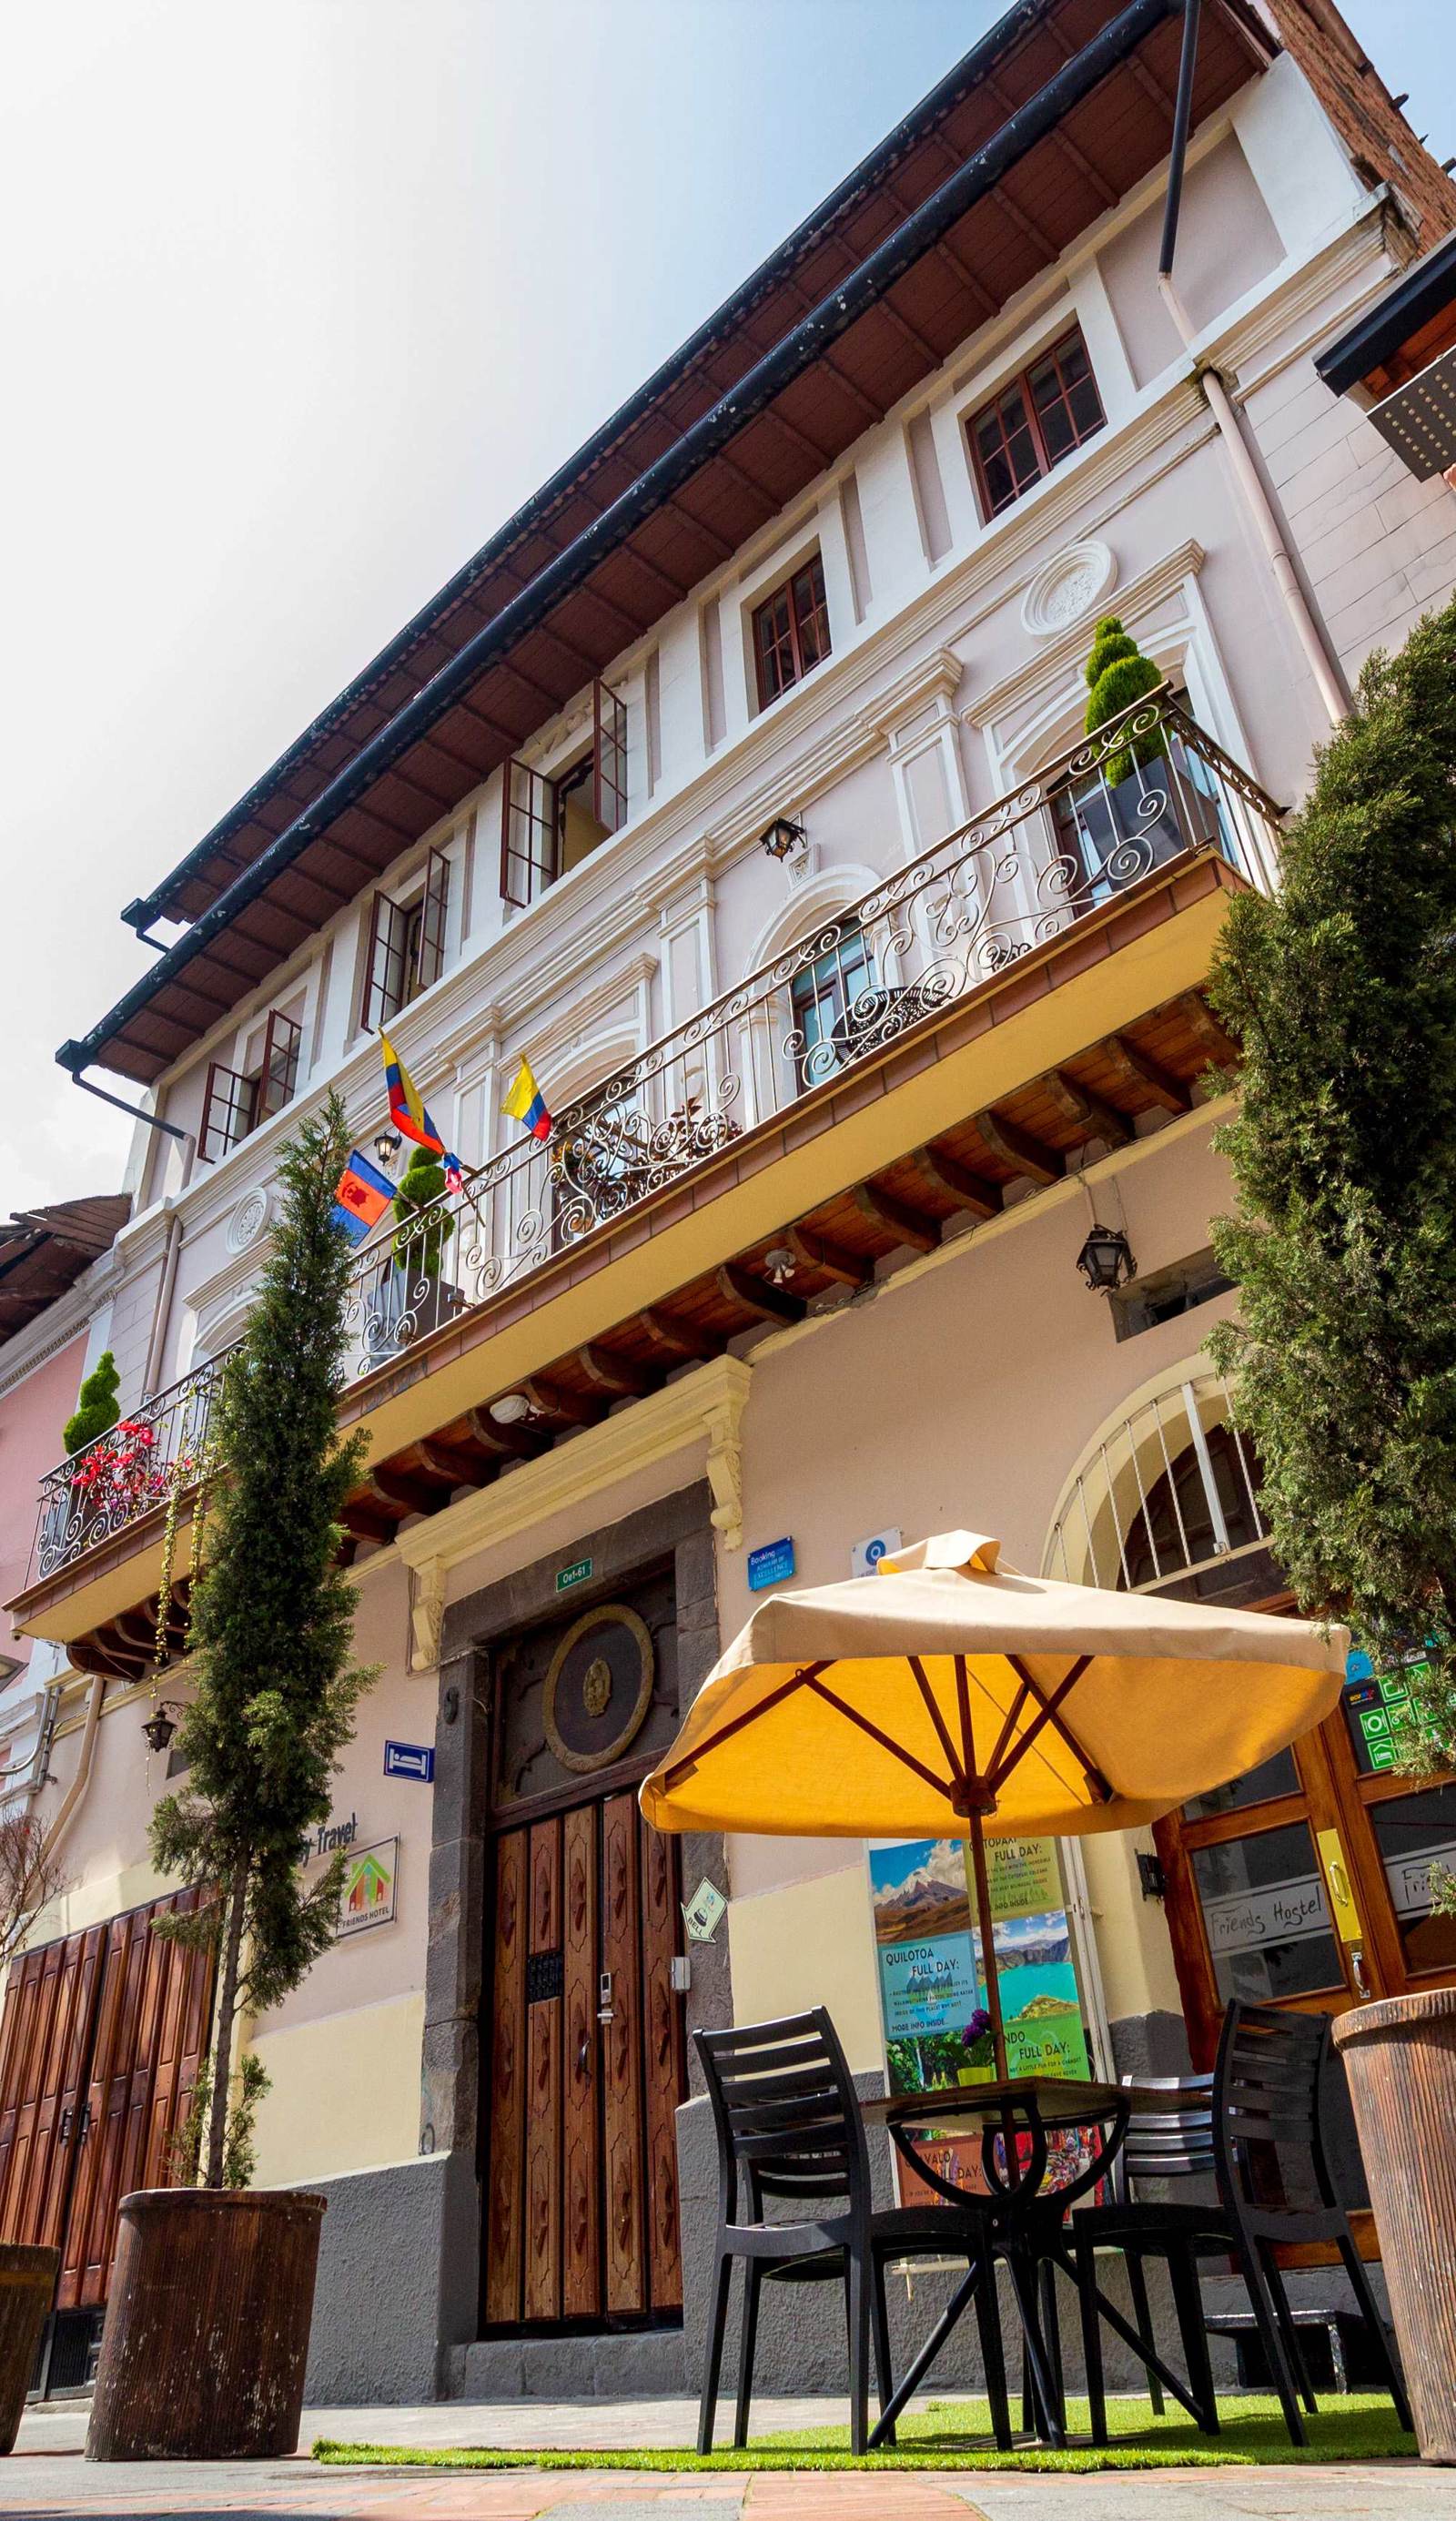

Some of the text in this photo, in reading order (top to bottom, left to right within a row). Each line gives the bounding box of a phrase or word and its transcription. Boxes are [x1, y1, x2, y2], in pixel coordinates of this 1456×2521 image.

[563, 1565, 586, 1584] Oe1-61
[969, 1838, 1016, 1851] CTOPAXI
[995, 1843, 1042, 1861] FULL DAY:
[342, 1906, 389, 1929] FRIENDS HOTEL
[1211, 1885, 1321, 1946] Friends Hostel
[688, 1917, 703, 1937] BELL
[885, 1948, 934, 1966] QUILOTOA
[912, 1959, 960, 1977] FULL DAY:
[892, 2023, 909, 2032] MORE
[911, 2020, 925, 2030] INFO
[1005, 2031, 1026, 2044] NDO
[1019, 2041, 1070, 2060] FULL DAY:
[958, 2165, 982, 2179] DAY:
